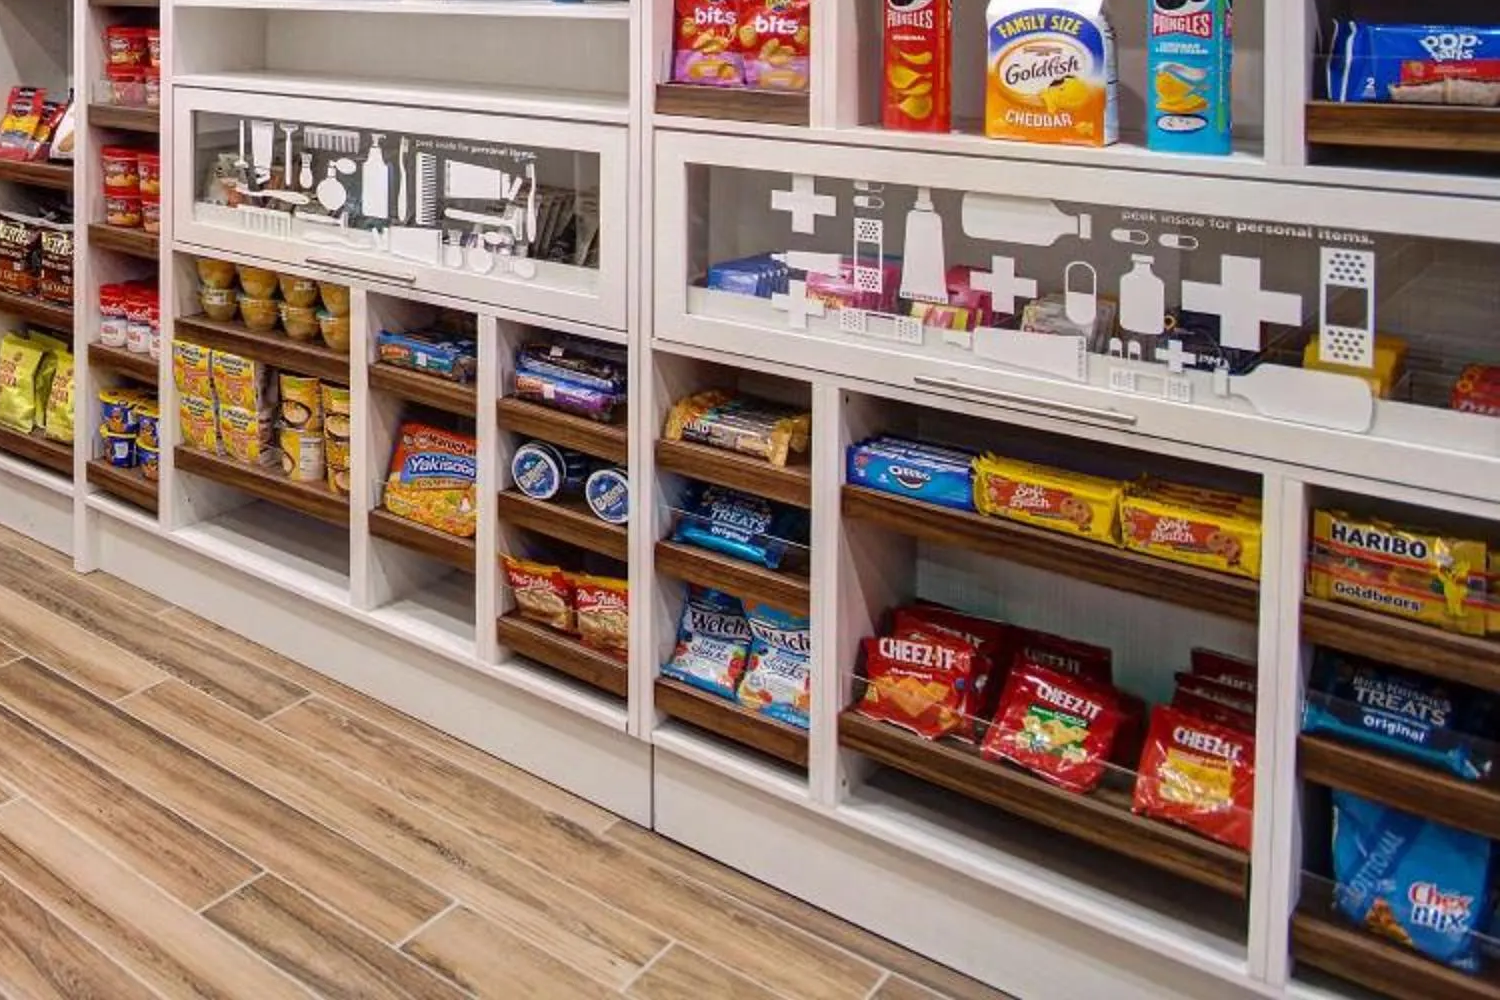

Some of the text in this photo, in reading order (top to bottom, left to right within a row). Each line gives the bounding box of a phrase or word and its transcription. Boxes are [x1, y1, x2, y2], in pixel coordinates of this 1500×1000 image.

[695, 6, 736, 25] bits
[755, 14, 799, 34] bits
[887, 9, 933, 30] PRINGLES
[996, 13, 1083, 39] FAMILY SIZE
[1153, 12, 1210, 38] PRINGLES
[1005, 56, 1081, 86] Goldfish
[1005, 110, 1073, 128] CHEDDAR
[1208, 216, 1231, 230] for
[1236, 221, 1314, 241] personal
[1331, 523, 1427, 559] HARIBO
[879, 637, 956, 669] CHEEZ-IT
[1036, 682, 1102, 719] CHEEZ-IT
[1354, 686, 1445, 727] TREATS
